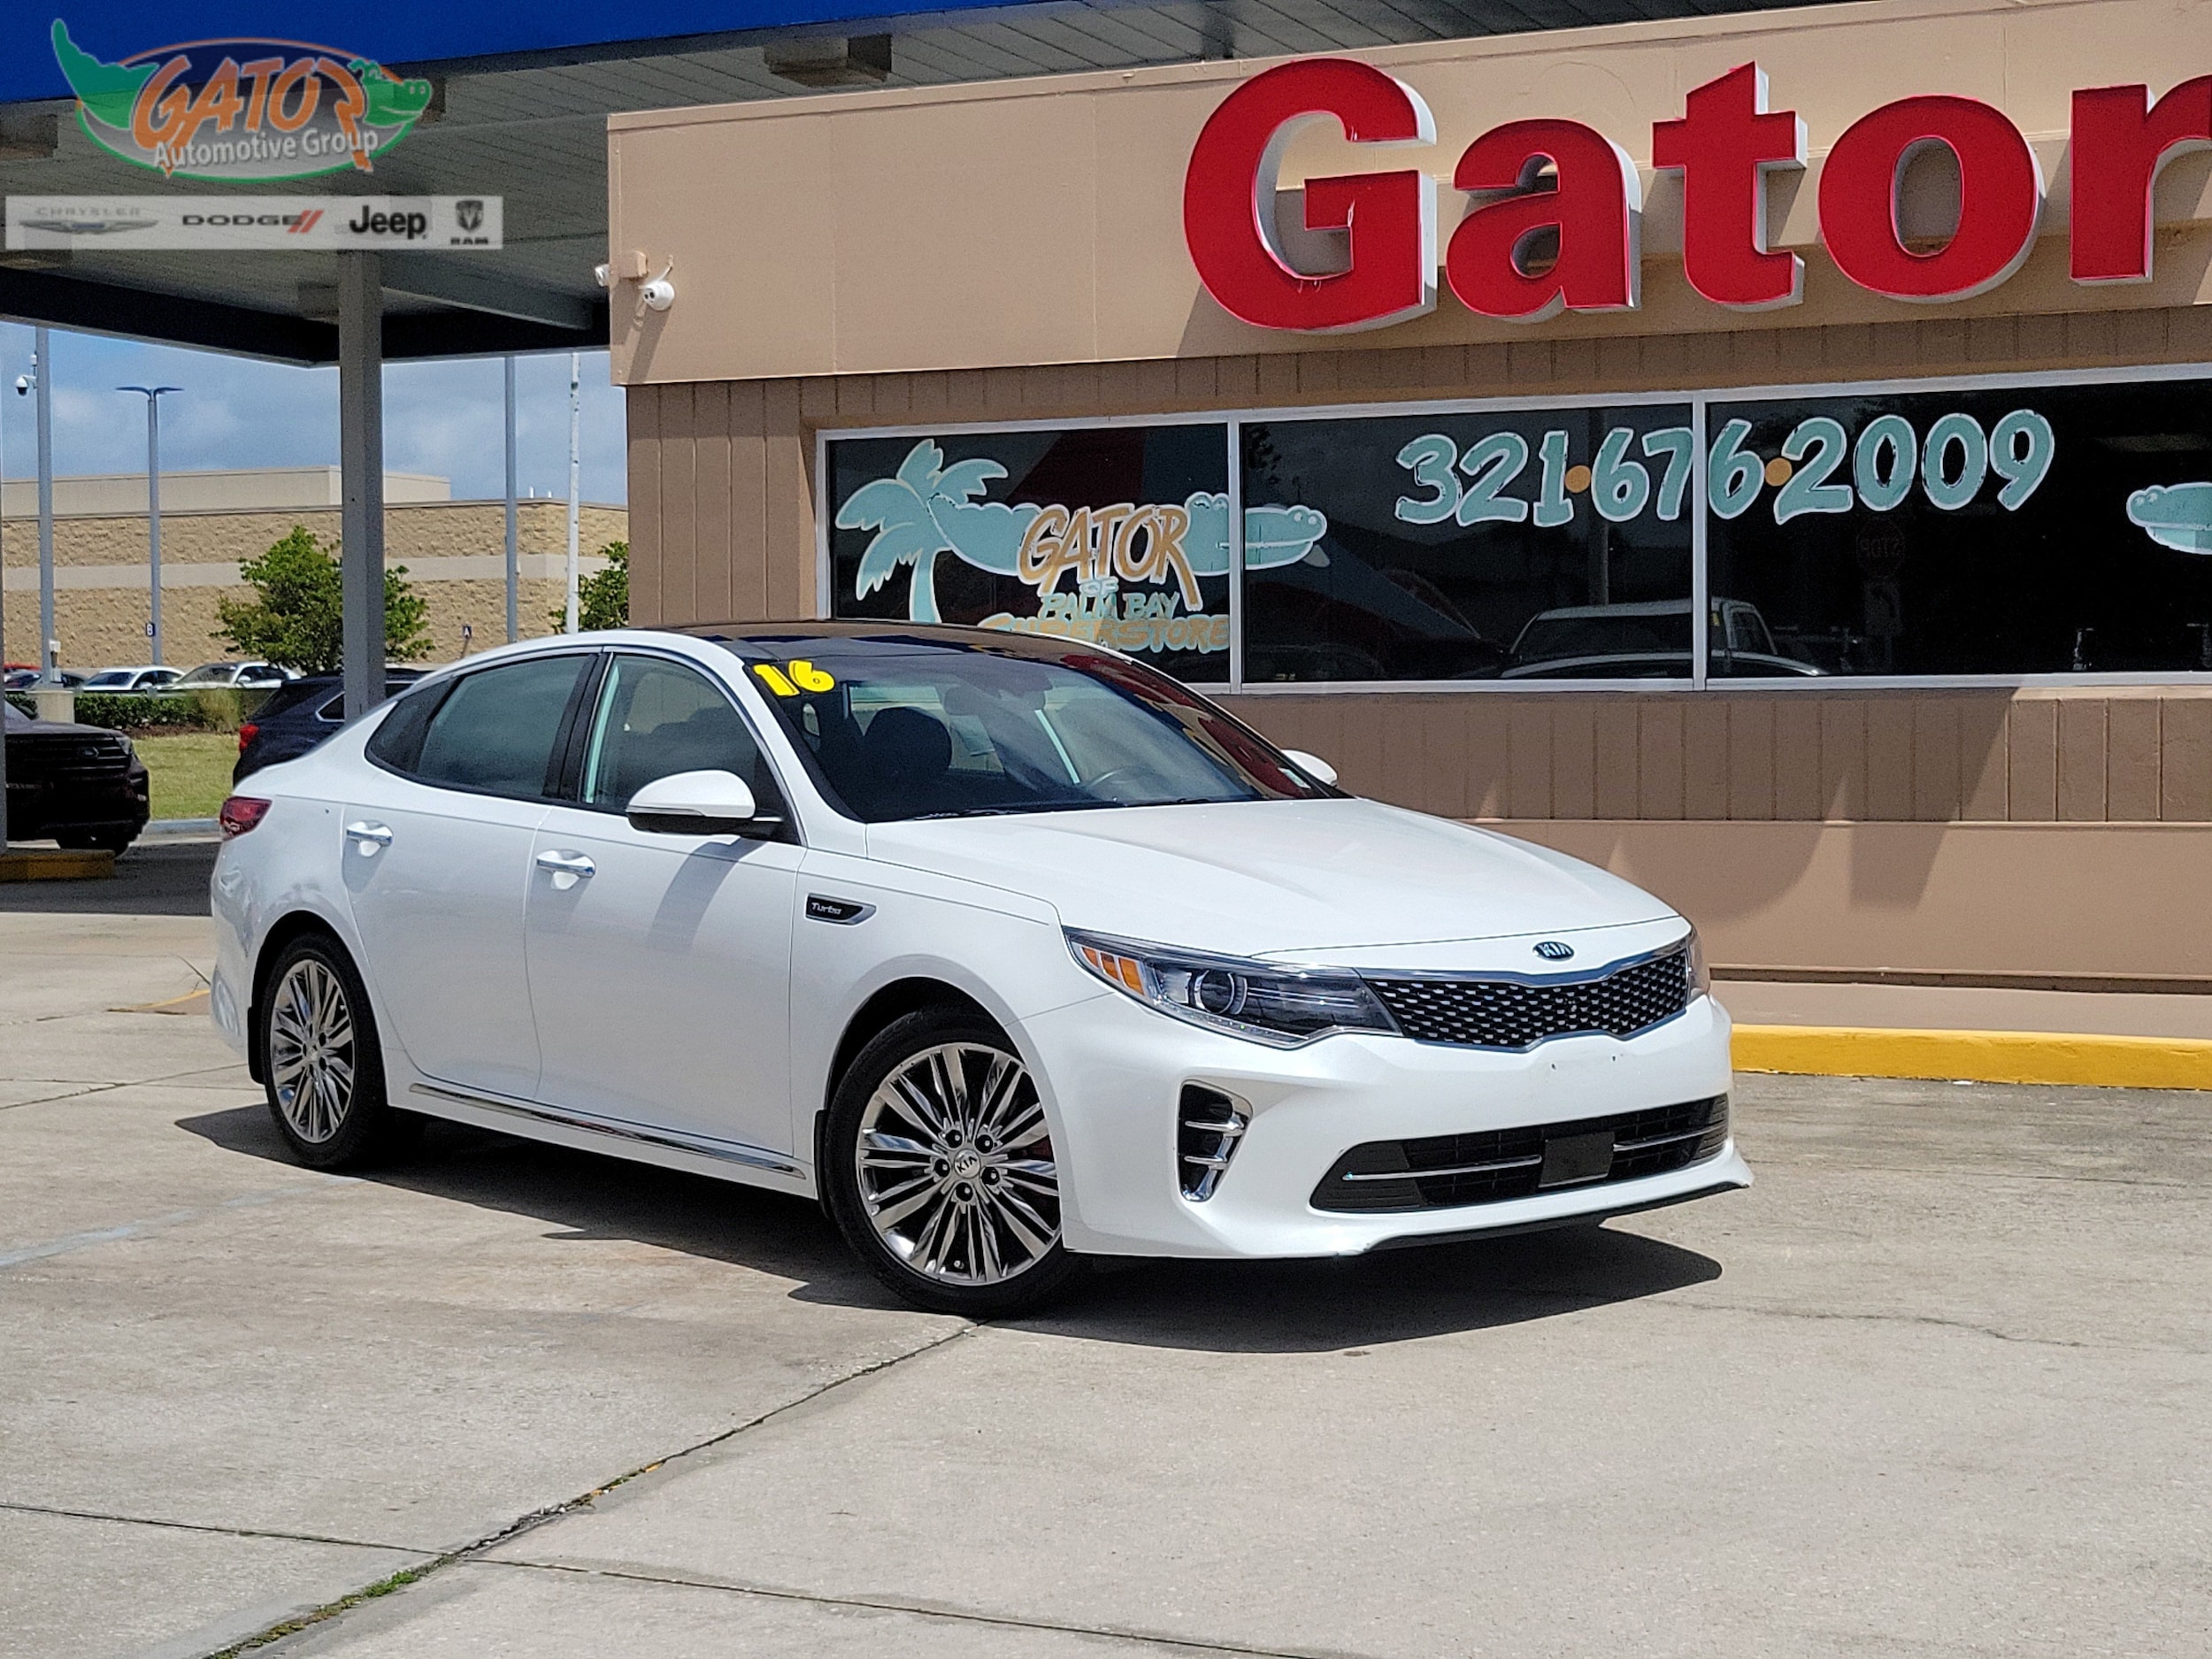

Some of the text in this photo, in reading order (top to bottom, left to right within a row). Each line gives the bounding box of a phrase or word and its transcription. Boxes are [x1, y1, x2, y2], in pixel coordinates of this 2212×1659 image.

[1183, 57, 2212, 334] Gator
[1018, 503, 1202, 611] GATOR
[1079, 575, 1119, 596] OF
[1038, 590, 1180, 620] PALM BAY
[753, 659, 835, 696] 16
[811, 902, 842, 915] Turbo
[1537, 942, 1572, 956] KIA
[956, 1156, 978, 1174] KIA
